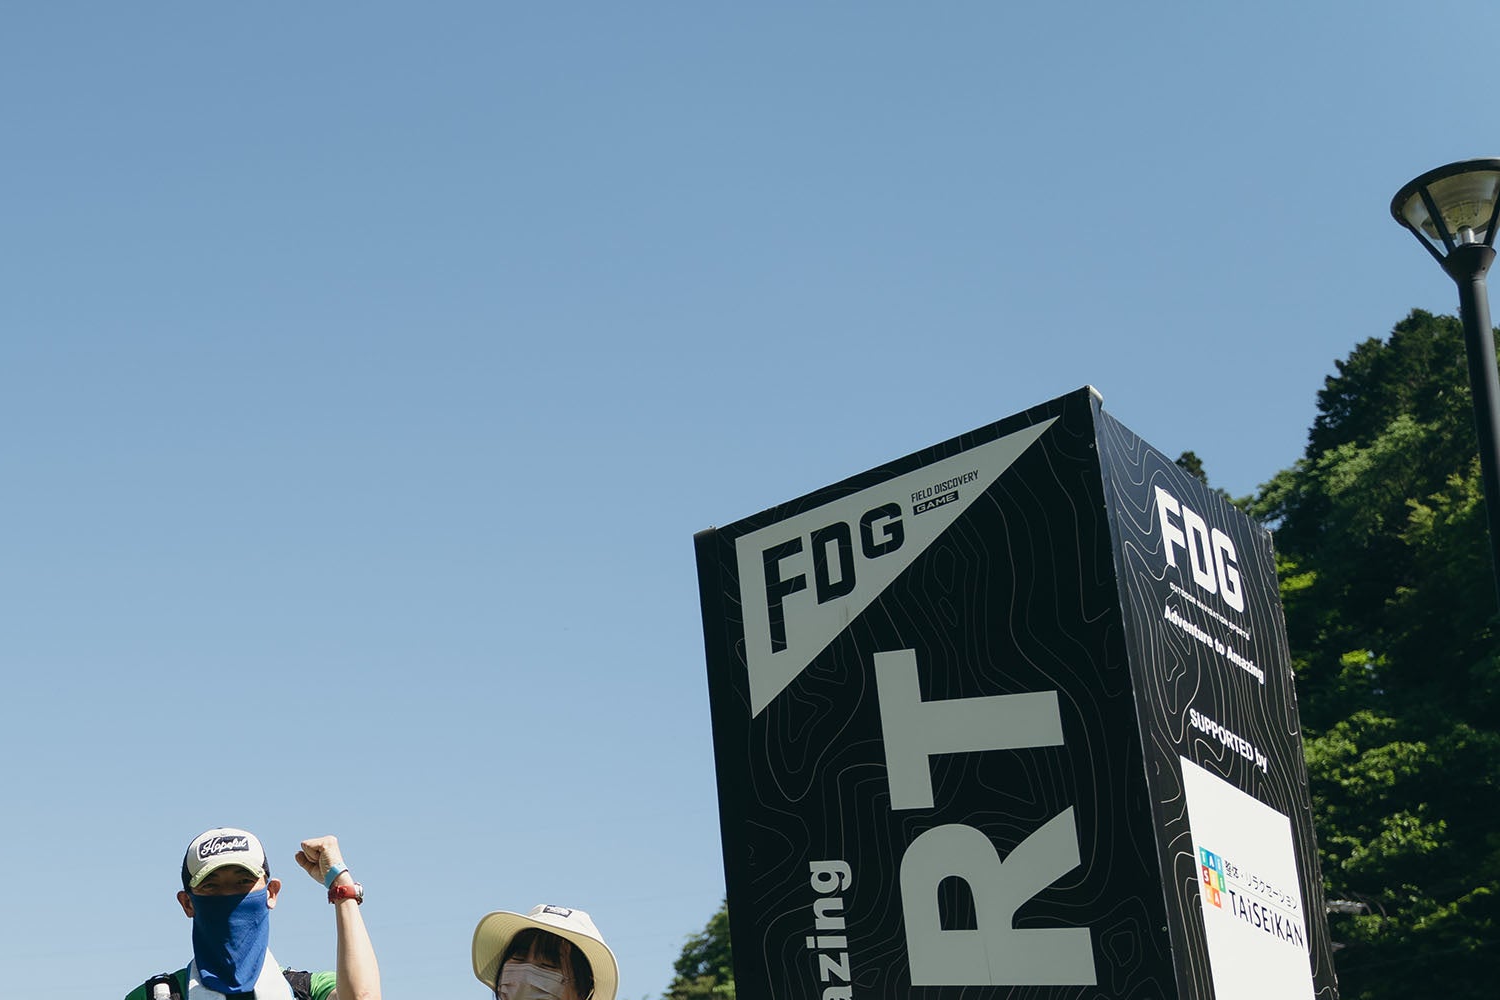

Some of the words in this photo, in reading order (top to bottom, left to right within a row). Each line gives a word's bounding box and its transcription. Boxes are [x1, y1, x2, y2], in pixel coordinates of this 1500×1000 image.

[911, 487, 933, 503] FIELD
[933, 470, 979, 495] DISCOVERY
[916, 493, 957, 513] GAME
[762, 502, 905, 654] FDG
[1155, 485, 1245, 613] FDG
[1164, 604, 1213, 648] Adventure
[1214, 638, 1225, 656] to
[1226, 645, 1264, 685] Amazing
[1190, 708, 1253, 762] SUPPORTED
[1254, 747, 1268, 774] by
